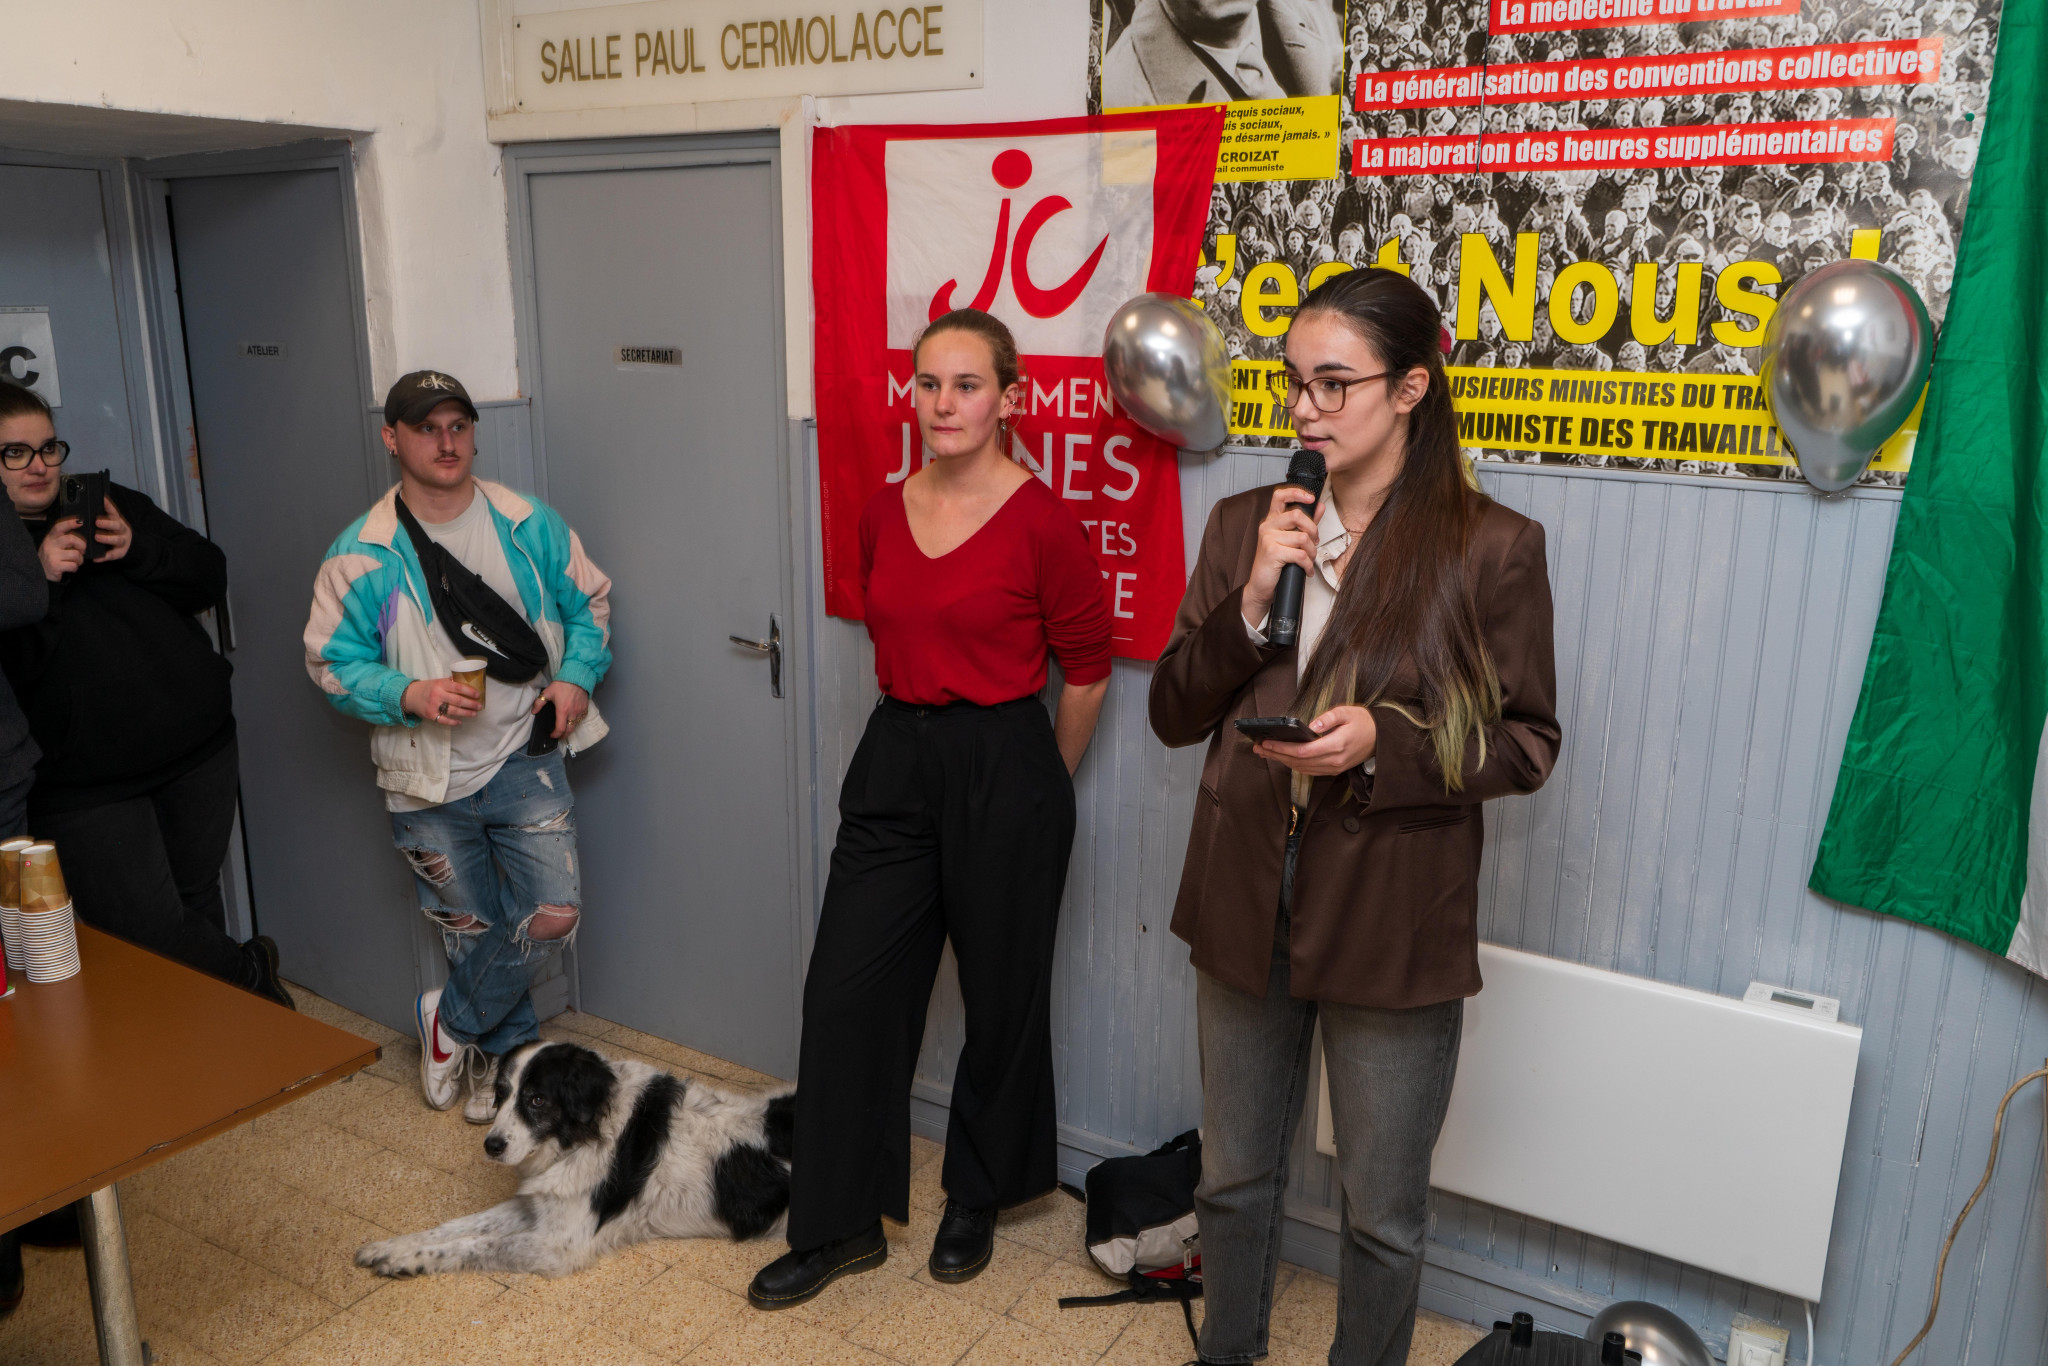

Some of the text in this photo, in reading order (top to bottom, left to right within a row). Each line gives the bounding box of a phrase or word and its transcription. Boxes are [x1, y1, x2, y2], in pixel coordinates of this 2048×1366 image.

[1500, 0, 1525, 25] La
[541, 5, 944, 84] SALLE PAUL CERMOLACCE
[1365, 48, 1936, 103] La généralisation des conventions collectives
[1261, 105, 1304, 116] sociaux,
[1235, 132, 1280, 143] désarme
[1282, 131, 1321, 143] jamais.
[1240, 119, 1282, 130] sociaux,
[1221, 150, 1279, 163] CROIZAT
[1361, 126, 1883, 169] La majoration des heures supplémentaires
[1230, 164, 1284, 173] communiste
[1455, 231, 1784, 348] Nous
[247, 345, 279, 356] ATELIER
[621, 348, 674, 364] SECRETARIAT
[1449, 376, 1544, 402] USIEURS
[1549, 379, 1675, 408] MINISTRES
[1681, 384, 1714, 409] DU
[1454, 411, 1574, 446] MUNISTE
[1579, 418, 1635, 449] DES
[885, 422, 1140, 501] JNES
